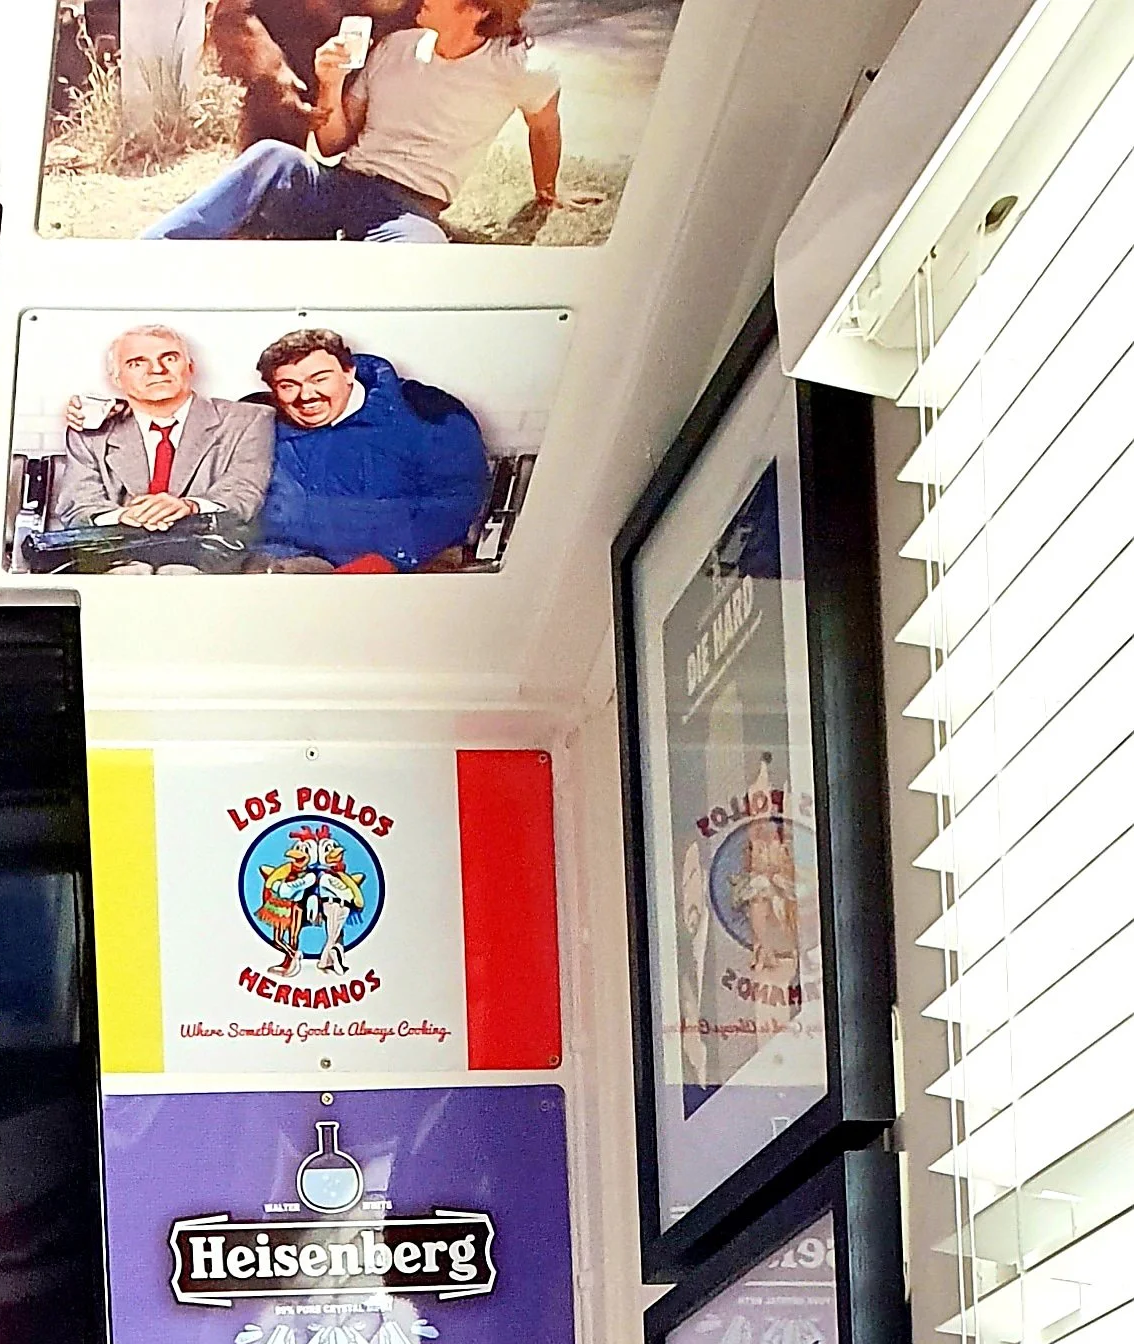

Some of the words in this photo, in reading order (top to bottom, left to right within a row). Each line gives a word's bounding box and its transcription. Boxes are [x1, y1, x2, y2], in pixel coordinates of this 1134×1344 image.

[713, 574, 753, 660] HARD
[227, 789, 282, 832] LOS
[297, 787, 394, 838] POLLOS
[239, 966, 382, 1009] HERMANOS
[180, 1022, 224, 1037] Where
[227, 1021, 294, 1043] Something
[297, 1022, 330, 1043] Good
[333, 1022, 345, 1036] is
[348, 1020, 395, 1043] Always
[188, 1227, 478, 1282] Heisenberg
